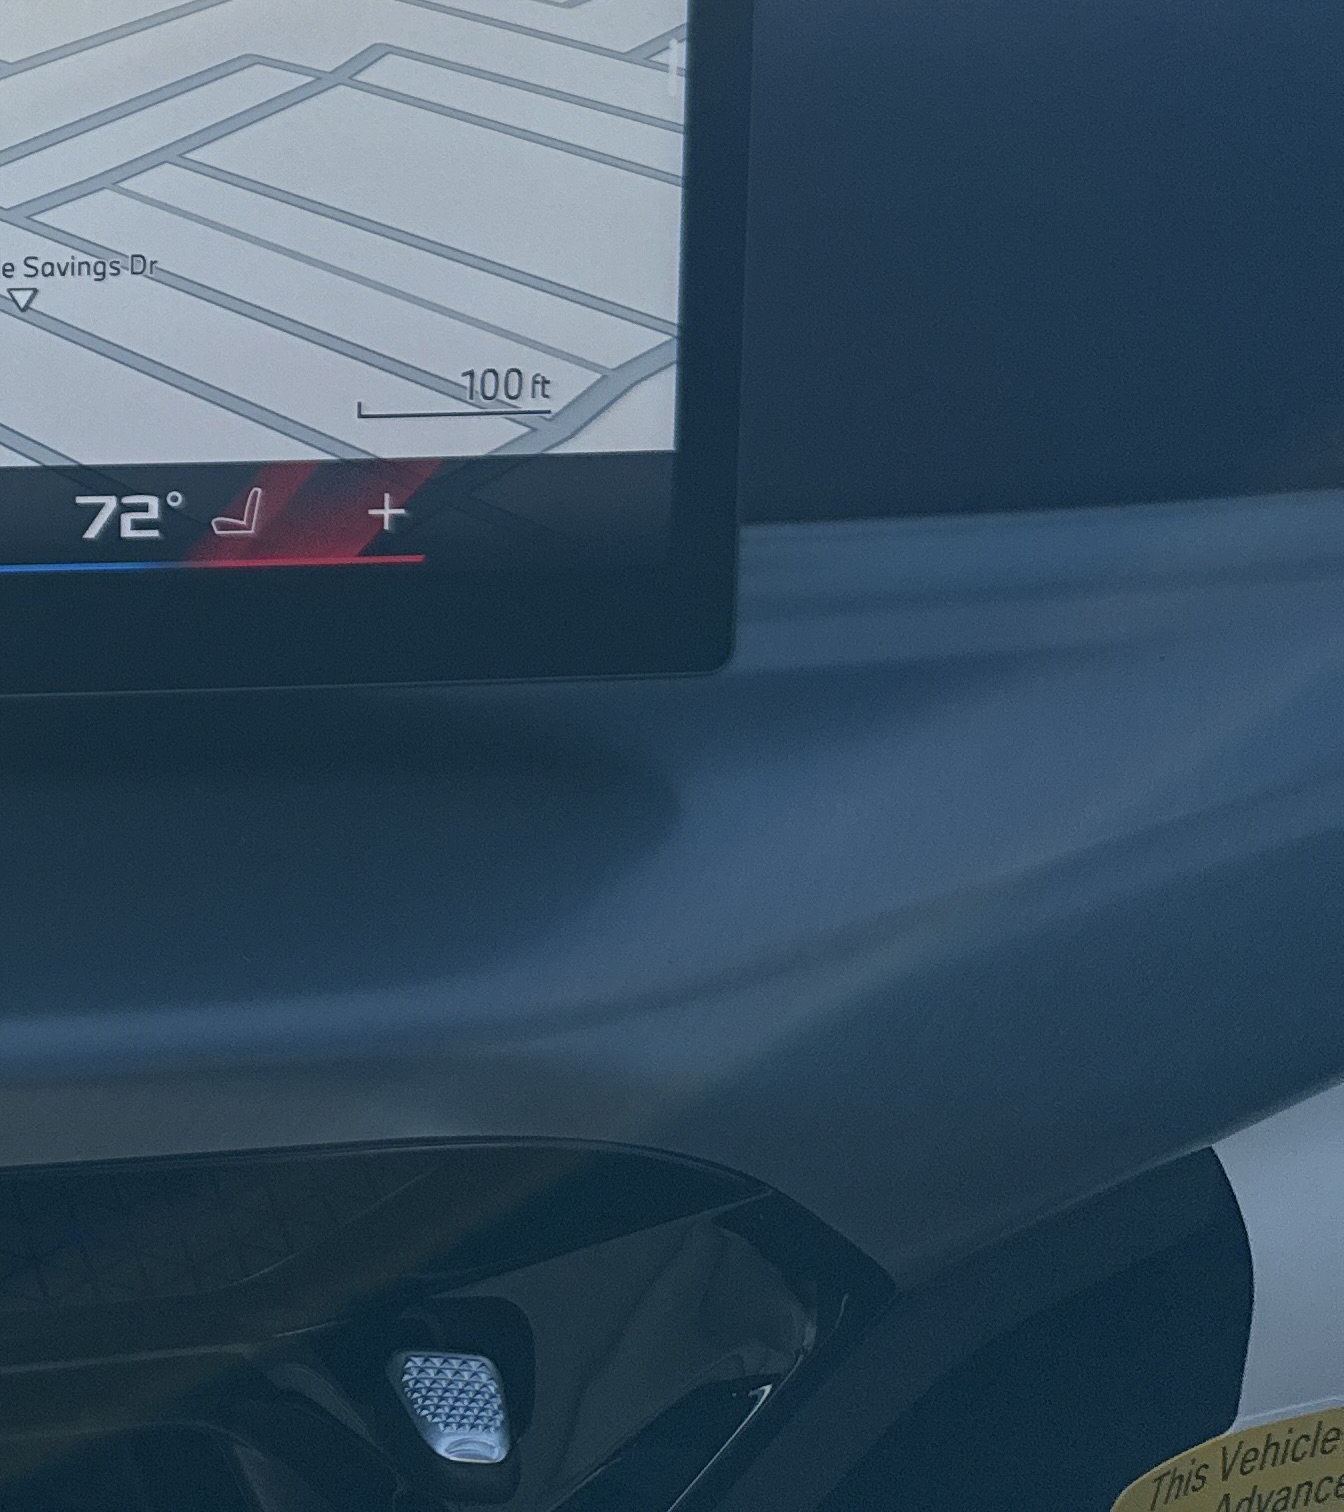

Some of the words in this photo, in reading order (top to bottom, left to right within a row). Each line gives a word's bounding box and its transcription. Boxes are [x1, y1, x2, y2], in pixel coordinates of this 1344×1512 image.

[23, 254, 121, 281] Savings
[130, 254, 159, 278] Dr
[461, 368, 524, 402] 100
[531, 373, 552, 400] ft
[74, 491, 184, 541] 72°
[1150, 1457, 1210, 1512] This
[1221, 1420, 1342, 1482] Vehicle
